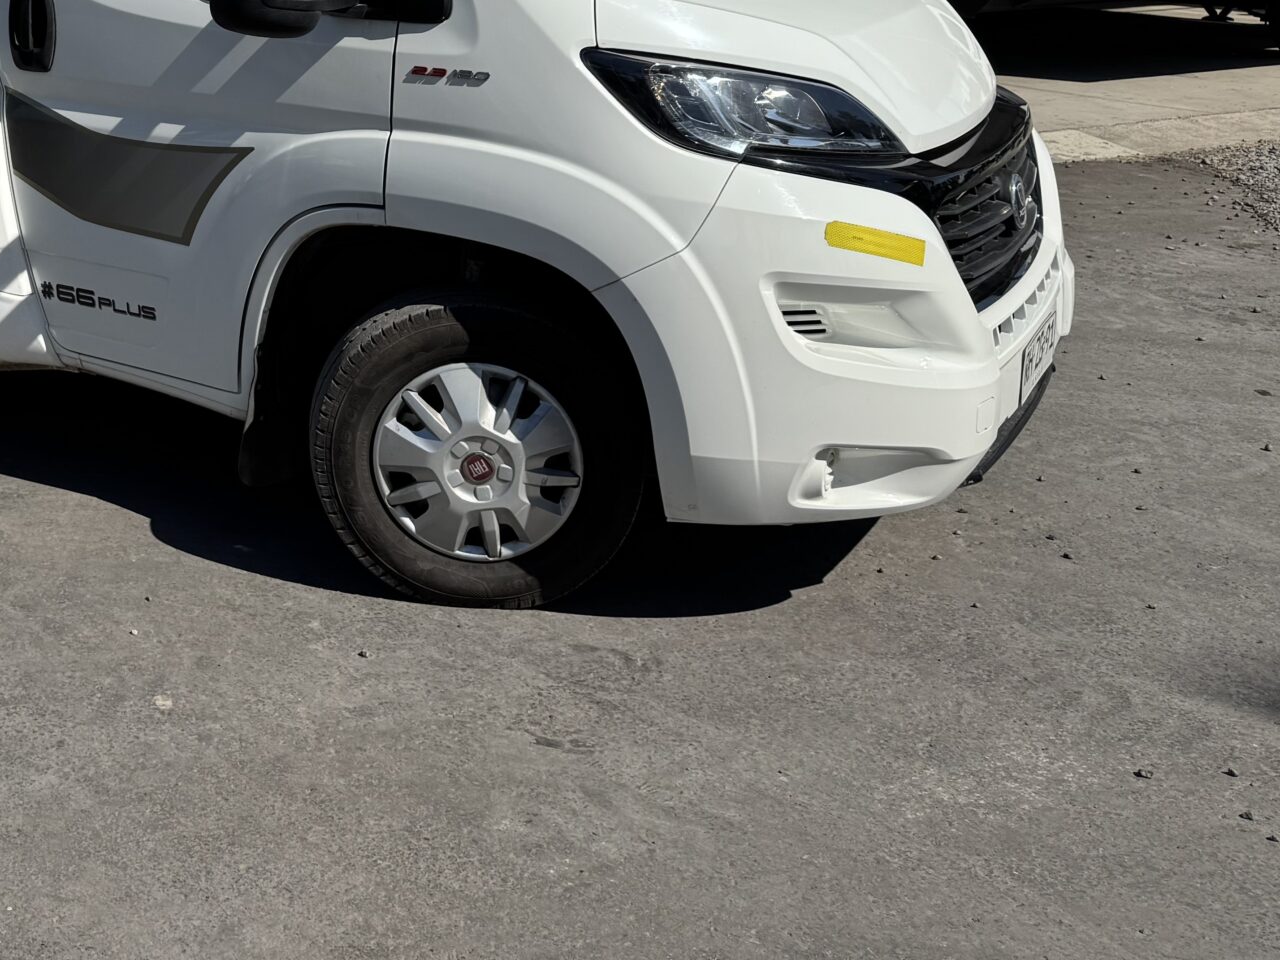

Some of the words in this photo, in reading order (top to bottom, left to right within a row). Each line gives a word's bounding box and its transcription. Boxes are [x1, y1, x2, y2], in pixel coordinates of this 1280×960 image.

[40, 280, 97, 308] #66
[97, 296, 157, 321] PLUS
[468, 458, 490, 478] FIAT
